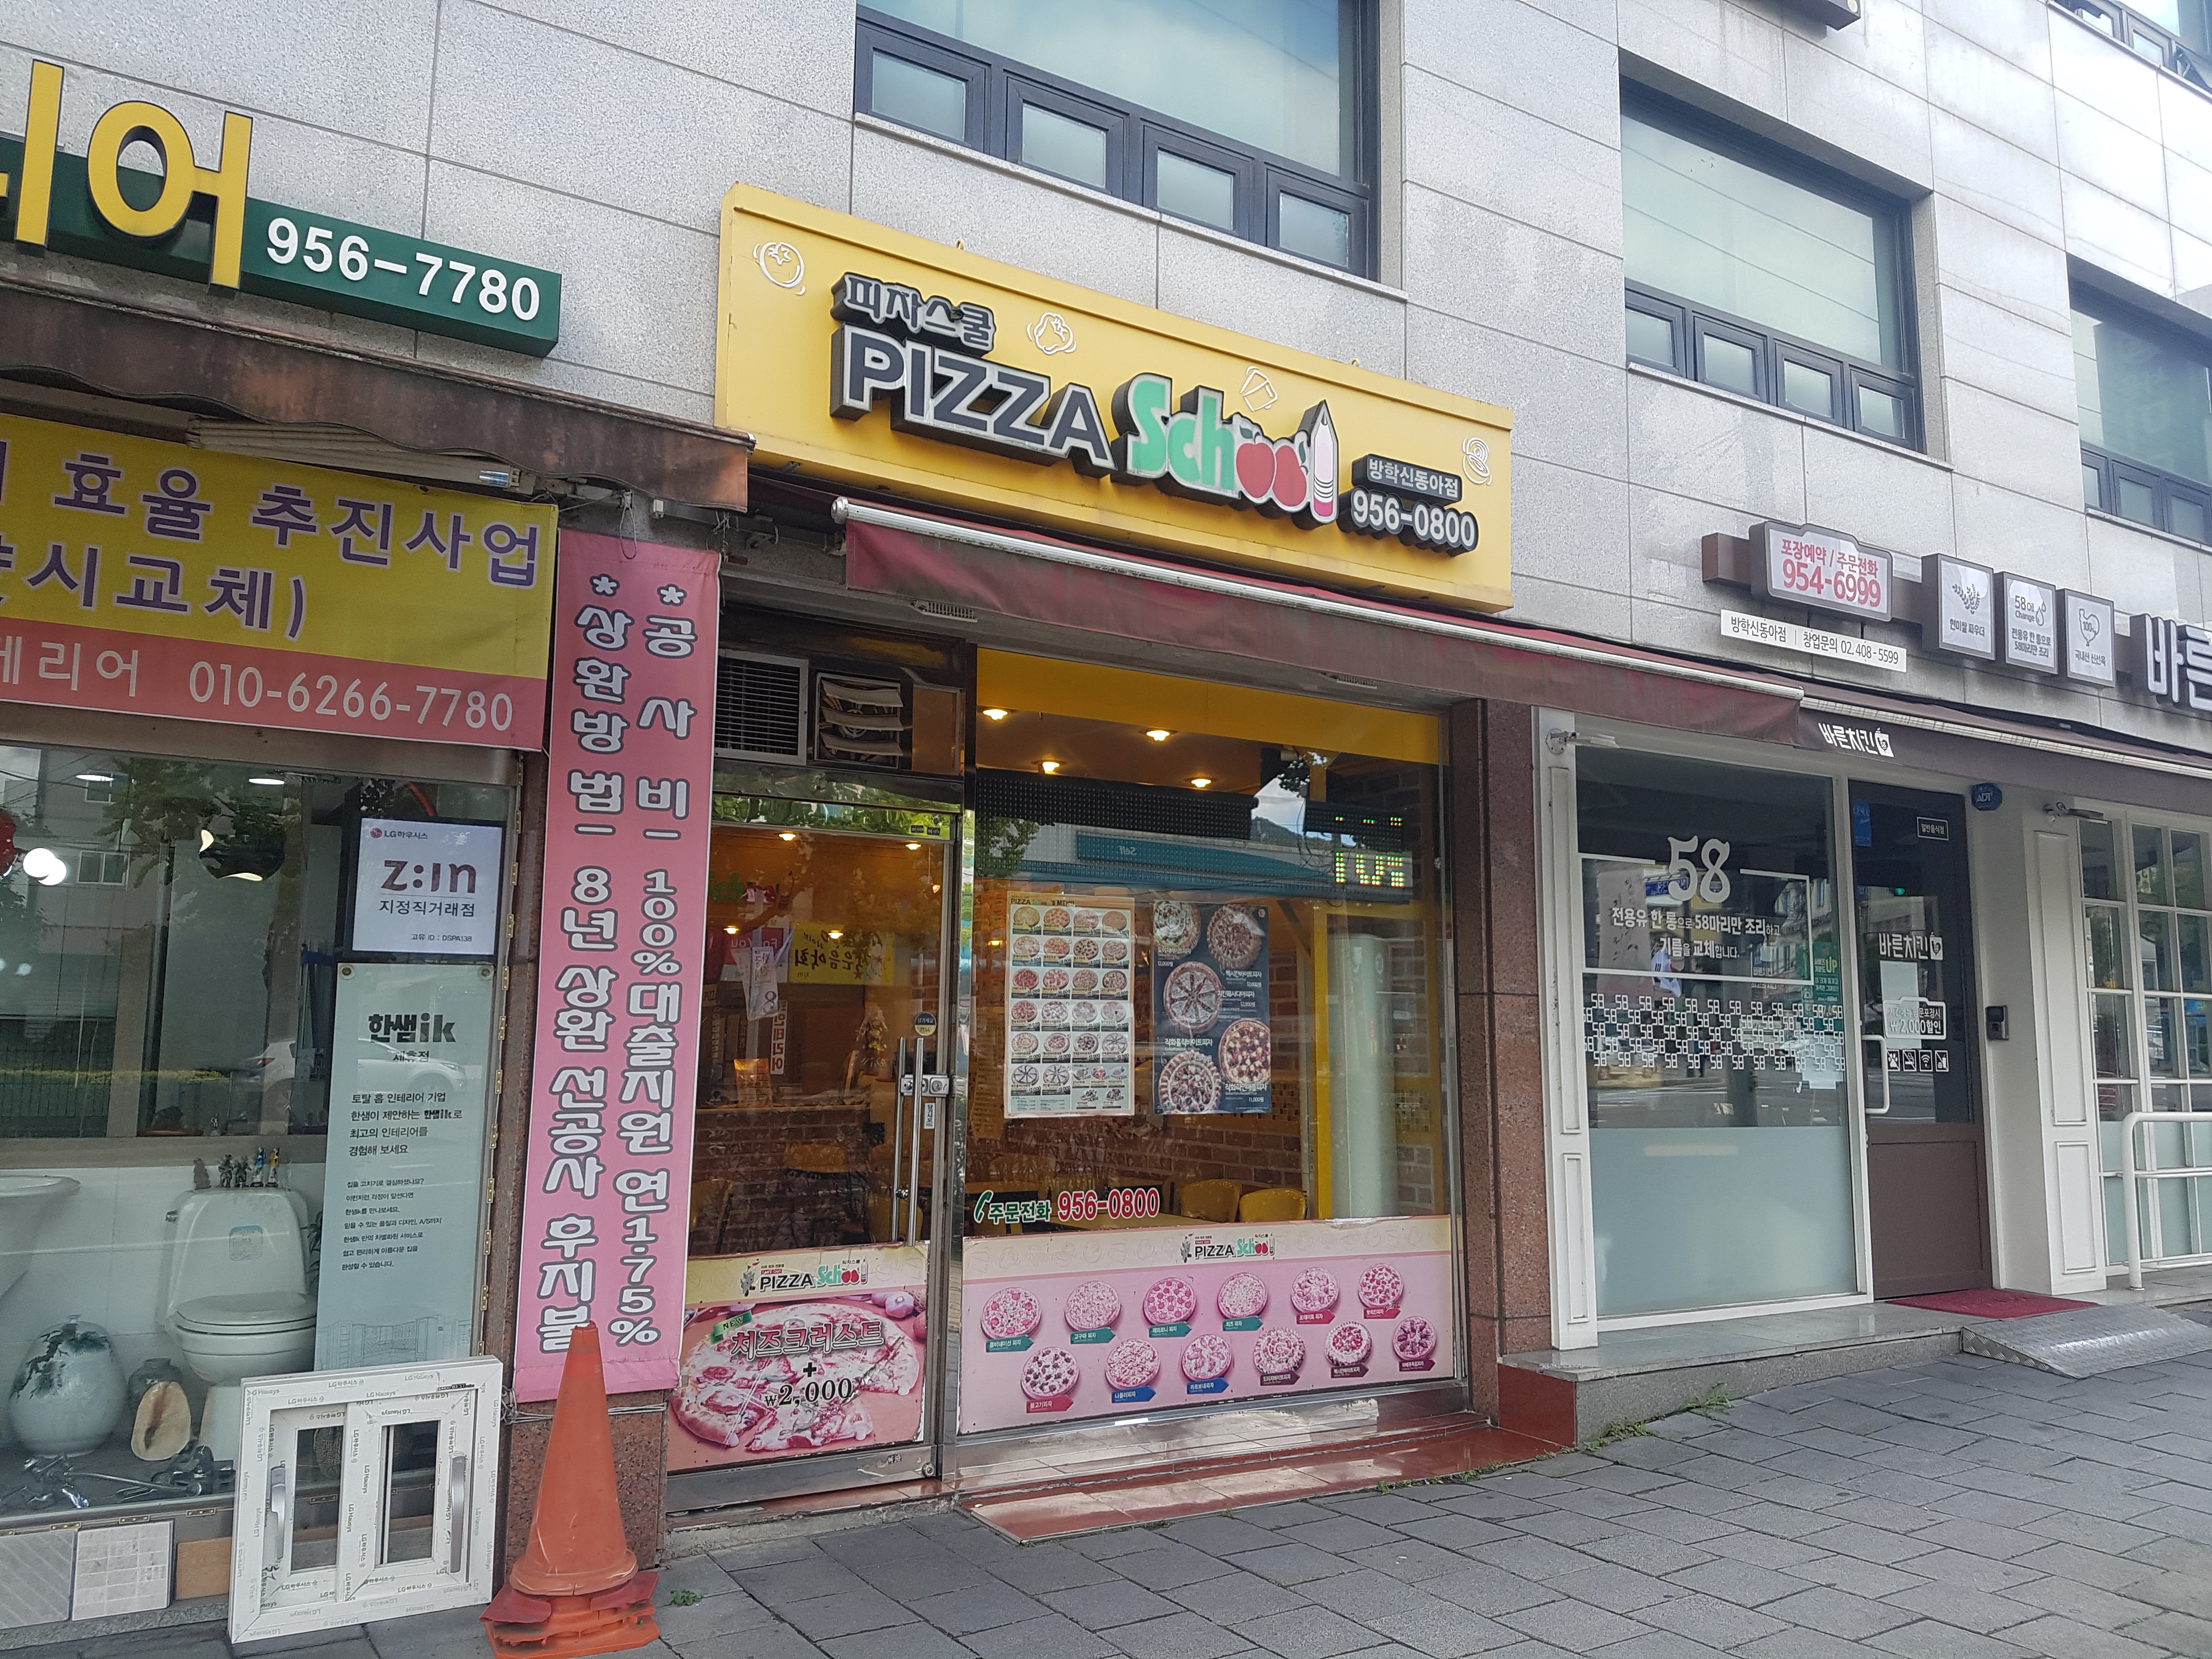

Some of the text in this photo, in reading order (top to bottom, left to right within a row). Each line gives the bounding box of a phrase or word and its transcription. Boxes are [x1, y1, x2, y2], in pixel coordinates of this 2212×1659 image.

[267, 217, 540, 321] 956-7780
[844, 275, 994, 352] 피자스쿨
[846, 328, 1114, 465] PIZZA
[1368, 460, 1459, 496] 방학신동아점
[52, 452, 213, 544] 효율
[249, 483, 540, 589] 추진사업
[1352, 489, 1476, 548] 956-0800
[1781, 539, 1827, 565] 포장예약
[1837, 552, 1878, 578] 주문전화
[1782, 558, 1881, 607] 954-6999
[2015, 595, 2026, 610] 58
[1950, 618, 1985, 637] 현미쌀 파우더
[2016, 610, 2034, 622] Change
[1731, 616, 1786, 642] 방학신동아점
[1803, 632, 1838, 653] 창업문의
[2012, 628, 2051, 646] 전용유 한 통으로
[2015, 641, 2049, 658] 58마리만 조리
[2075, 649, 2106, 666] 국내산 신선육
[189, 659, 513, 732] 010-6266-7780
[1819, 723, 1877, 755] 바른치킨
[1976, 792, 1992, 803] ADT
[384, 830, 428, 839] LG하우시스
[1667, 835, 1731, 904] 58
[379, 900, 475, 917] 지정직거래점
[1612, 907, 1780, 936] 전용유 한 통으로 58마리만 조리하고
[1660, 937, 1740, 958] 기름을 교체합니다.
[1879, 933, 1928, 960] 바른치킨
[1591, 994, 1842, 1019] 58 58 58 58 58 58 58
[351, 1092, 445, 1104] 토탈 홈 인테리어 기업
[351, 1111, 379, 1121] 한샘이
[382, 1110, 420, 1120] 제안하는
[349, 1127, 427, 1138] 최고의 인테리어를
[349, 1144, 408, 1156] 경험해 보세요
[988, 1188, 1160, 1224] 주문전화 956-0800
[1195, 1244, 1235, 1259] PIZZA
[760, 1273, 815, 1291] PIZZA
[722, 1316, 744, 1330] NEW
[731, 1320, 884, 1361] 치즈크러스트
